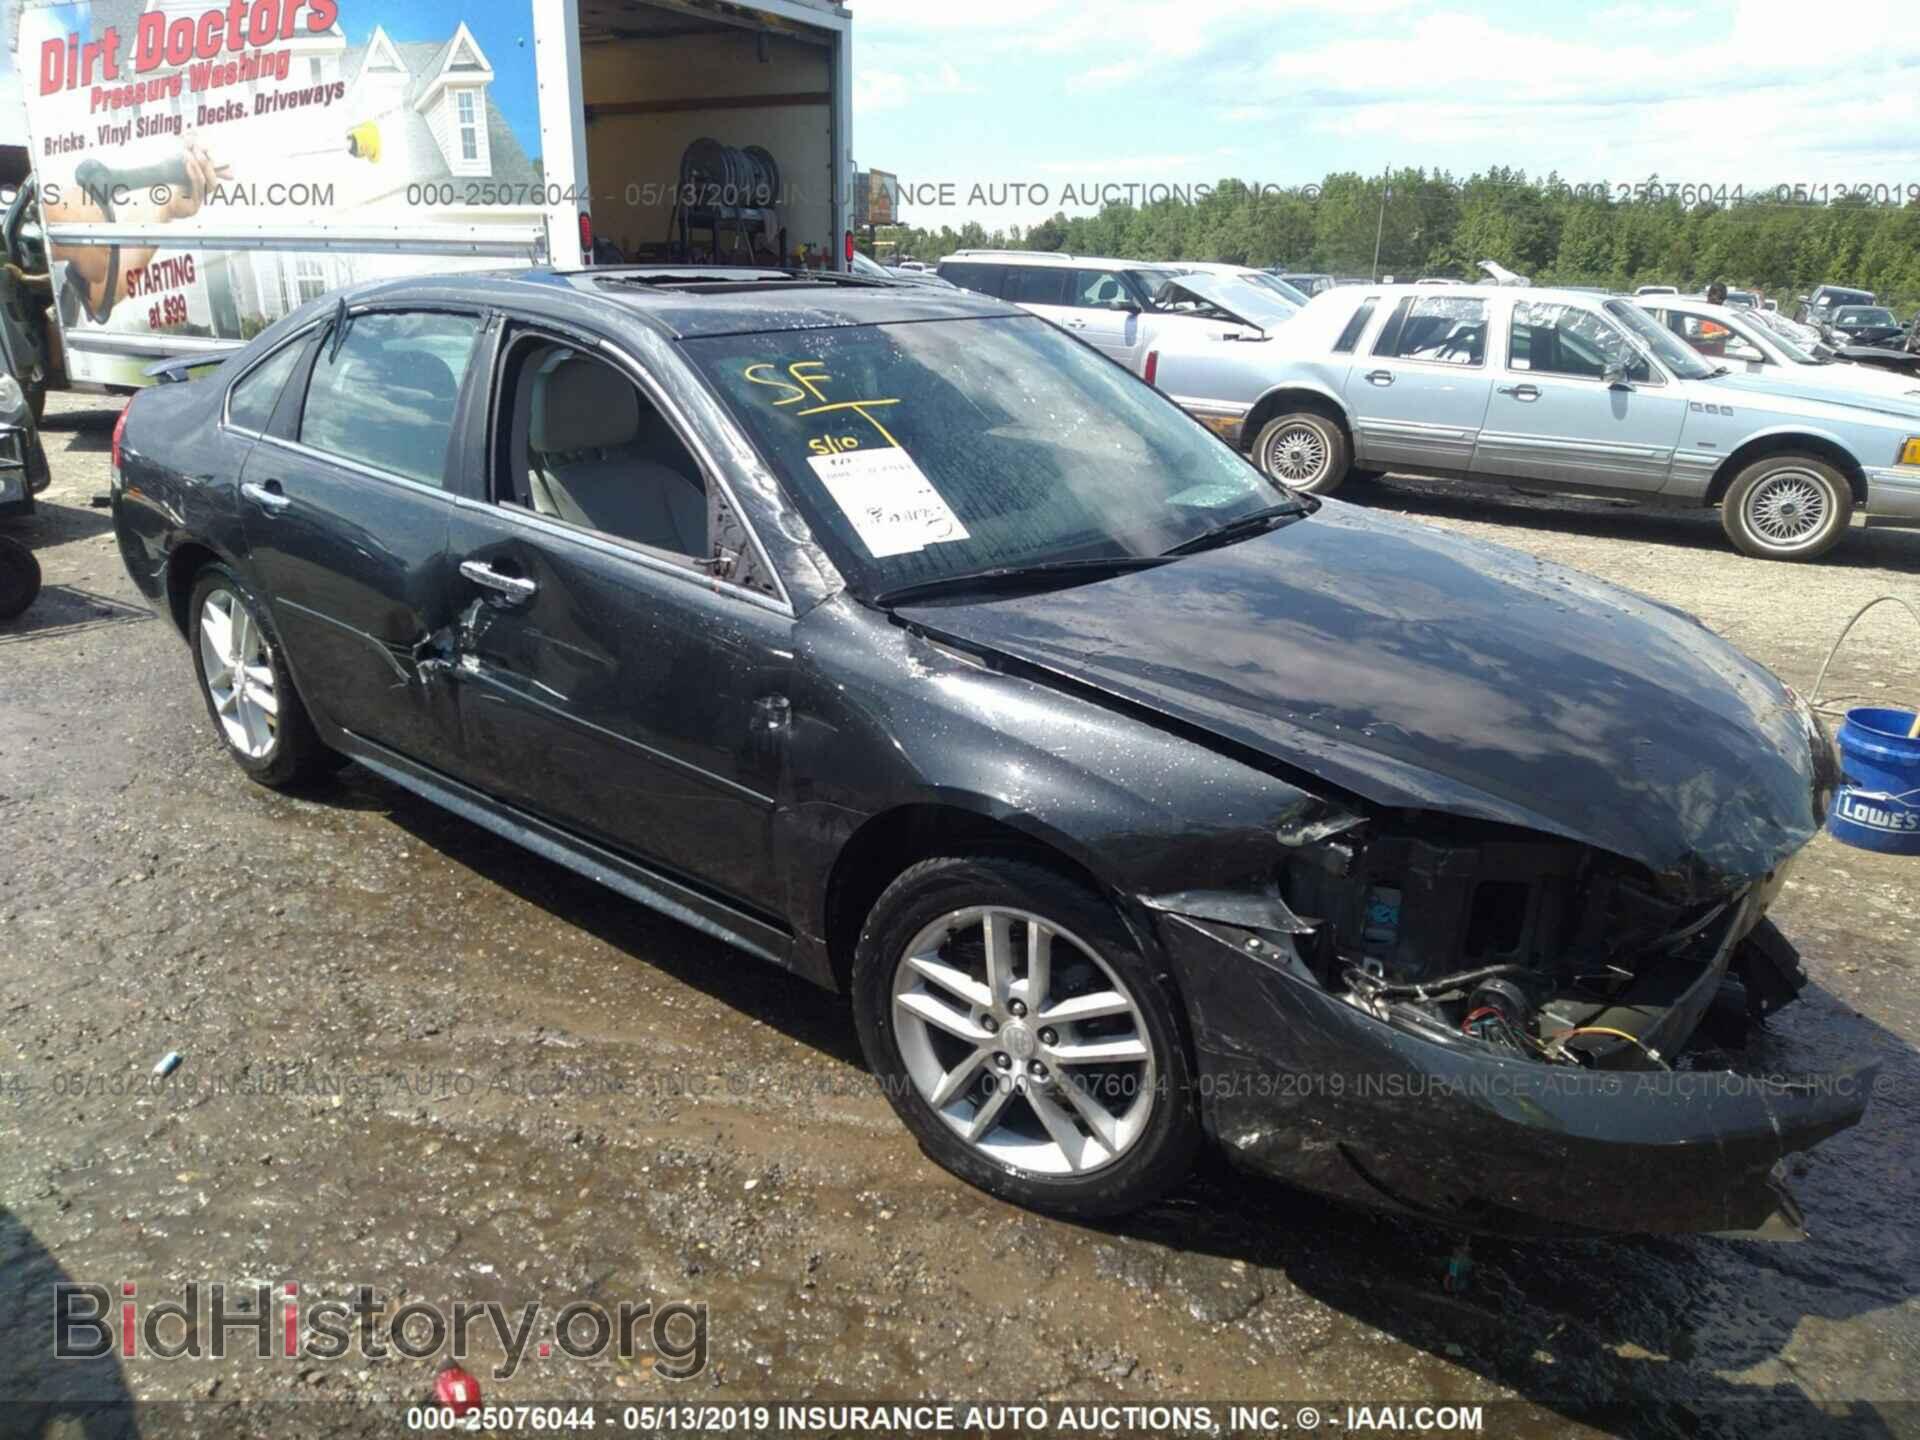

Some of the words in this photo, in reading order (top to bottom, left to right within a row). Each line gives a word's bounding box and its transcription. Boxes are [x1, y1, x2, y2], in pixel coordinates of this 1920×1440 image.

[40, 25, 121, 96] Dirt
[135, 0, 338, 74] Doctors
[90, 72, 183, 114] Pressure
[188, 49, 292, 93] Washing
[44, 132, 86, 157] Bricks
[97, 121, 131, 149] Vinyl
[136, 114, 183, 138] Siding
[253, 81, 345, 116] Driveways
[126, 253, 197, 299] STARTING
[148, 305, 162, 329] at
[164, 293, 188, 326] $99
[1842, 797, 1920, 830] LOWE'S
